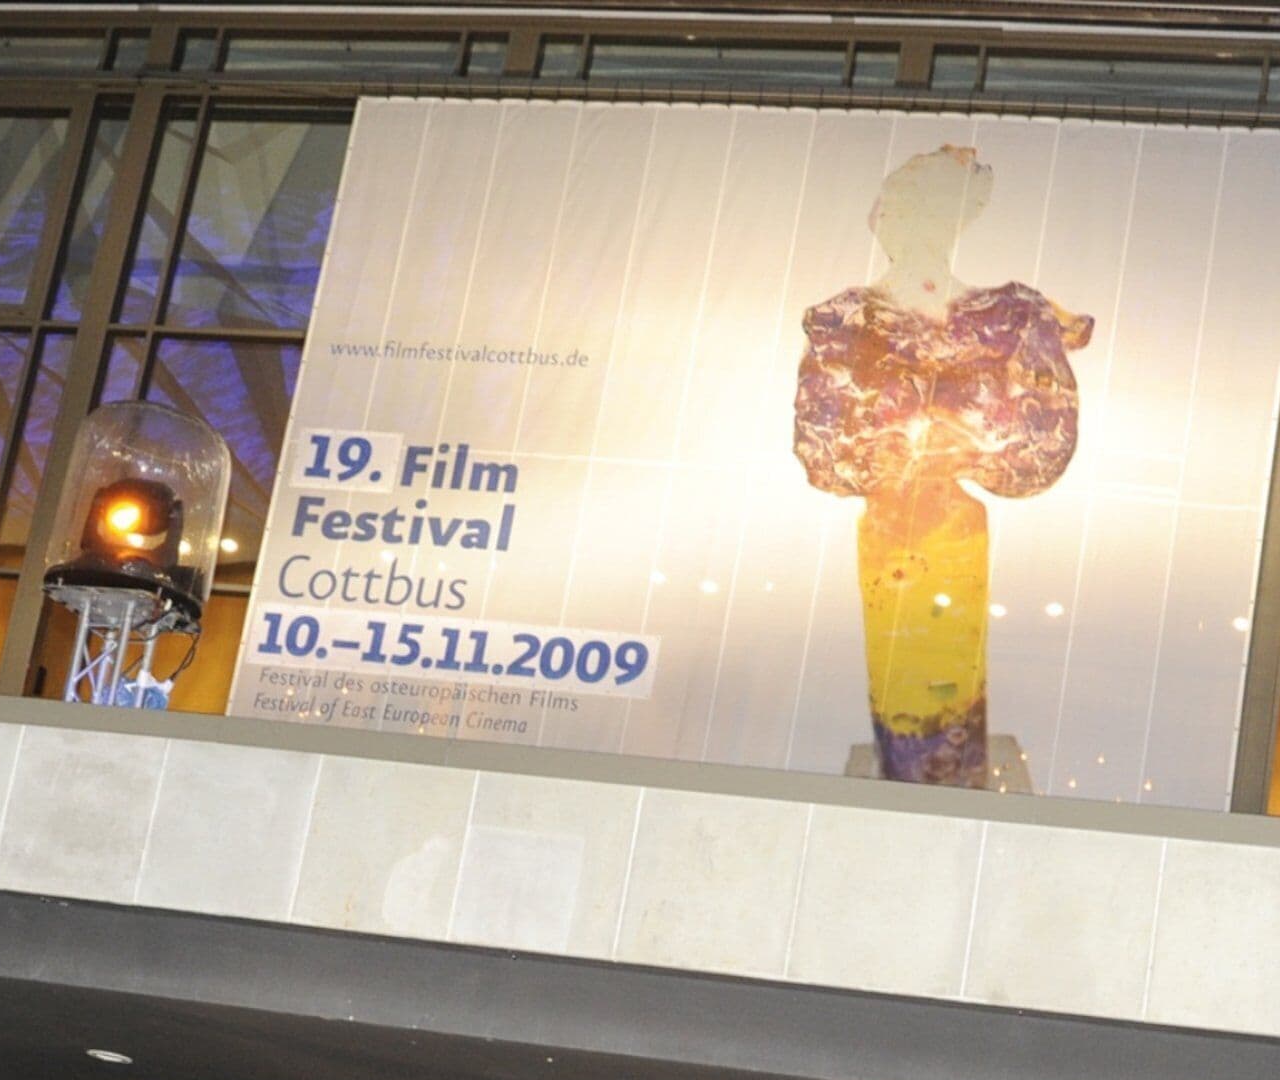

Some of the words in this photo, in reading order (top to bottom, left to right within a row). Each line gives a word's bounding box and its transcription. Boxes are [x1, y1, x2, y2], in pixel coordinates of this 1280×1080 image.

[330, 340, 589, 368] www.filmfestivalcottbus.de
[303, 434, 382, 482] 19.
[400, 444, 519, 493] Film
[291, 496, 516, 551] Festival
[278, 554, 468, 611] Cottbus
[253, 691, 314, 714] Festival
[319, 697, 336, 722] of
[341, 700, 377, 720] East
[382, 703, 460, 730] European
[465, 711, 528, 734] Cinema
[259, 667, 328, 689] Festival
[333, 673, 364, 692] des
[370, 677, 522, 707] osteuropäischen
[529, 689, 580, 713] Films
